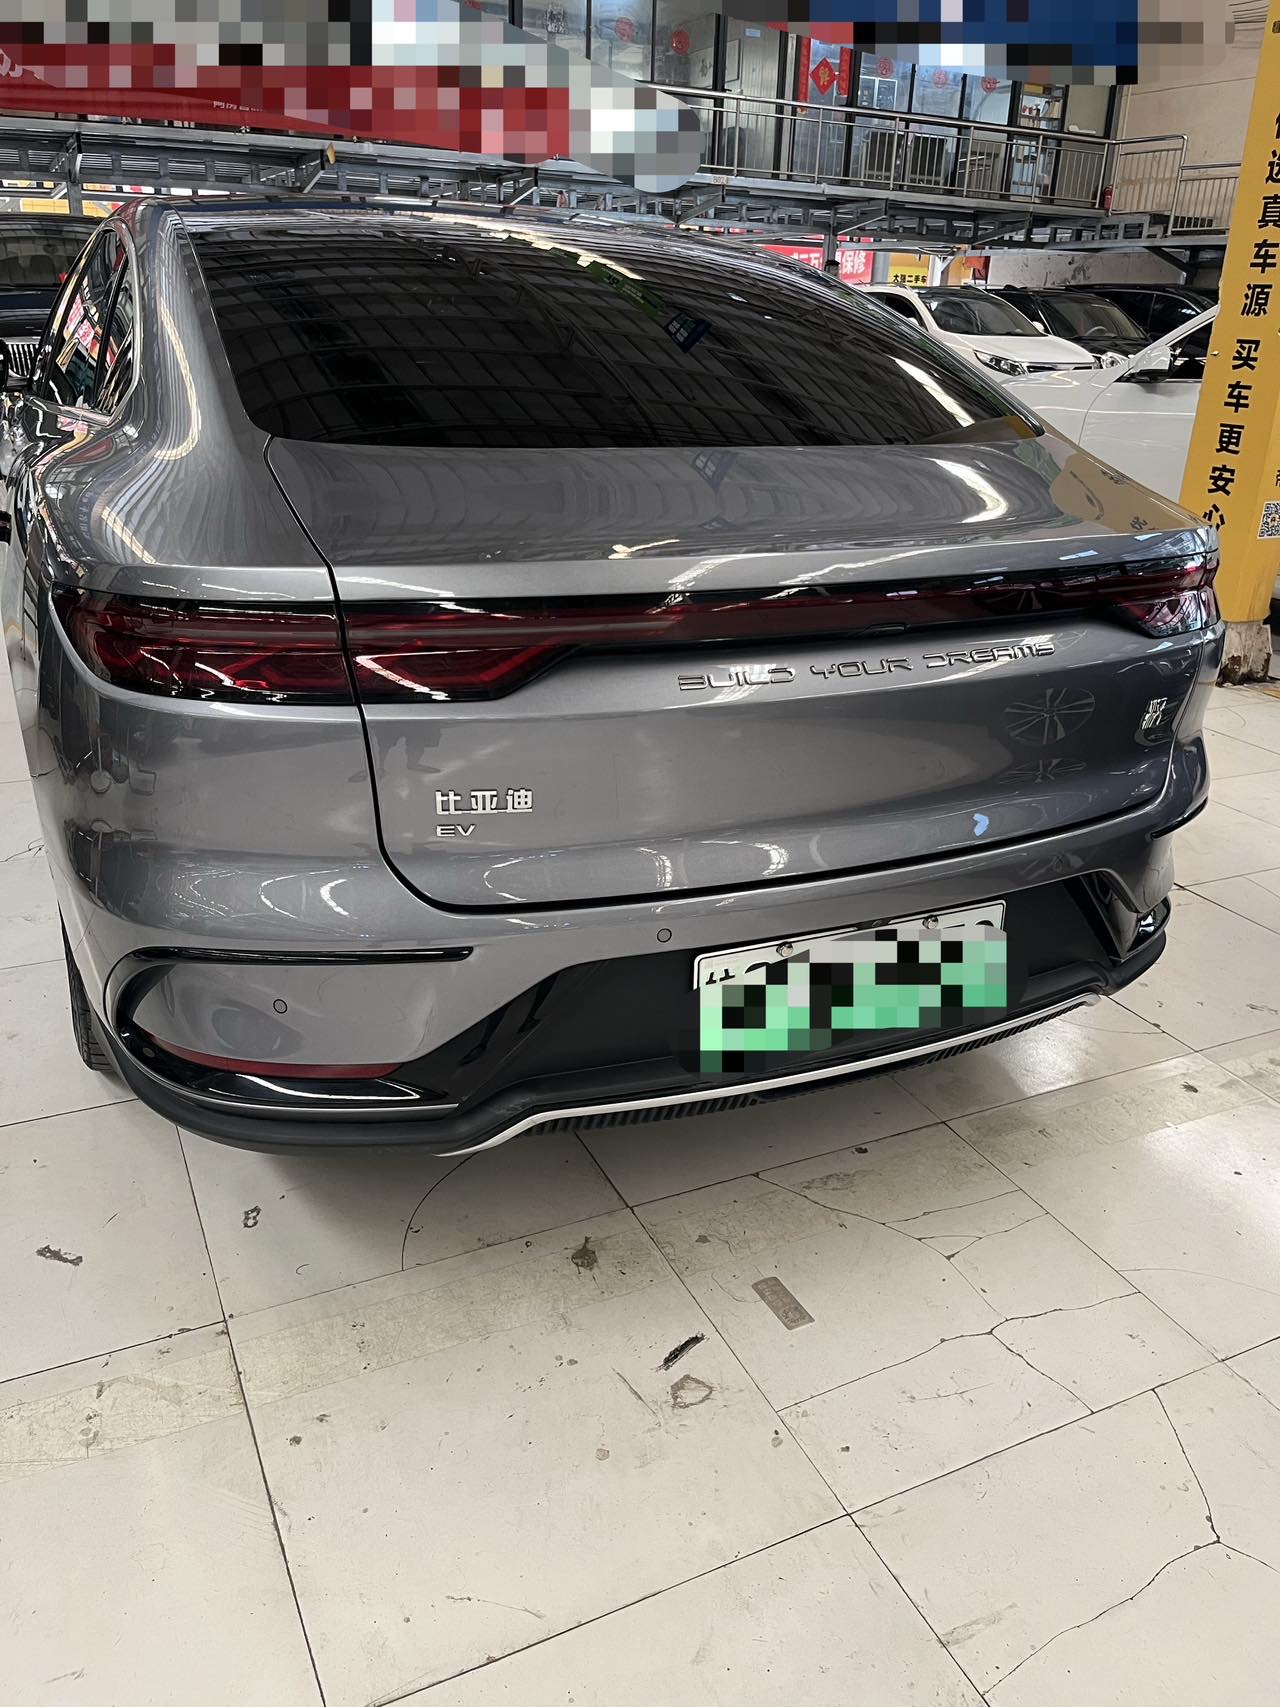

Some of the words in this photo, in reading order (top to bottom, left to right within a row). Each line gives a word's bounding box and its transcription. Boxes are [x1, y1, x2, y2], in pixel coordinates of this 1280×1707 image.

[1203, 338, 1261, 531] 买车更安心
[678, 666, 796, 690] BUILD
[810, 657, 914, 680] YOUR
[922, 642, 1056, 668] DREAMS
[435, 788, 533, 815] 比亚迪
[436, 824, 476, 837] EV
